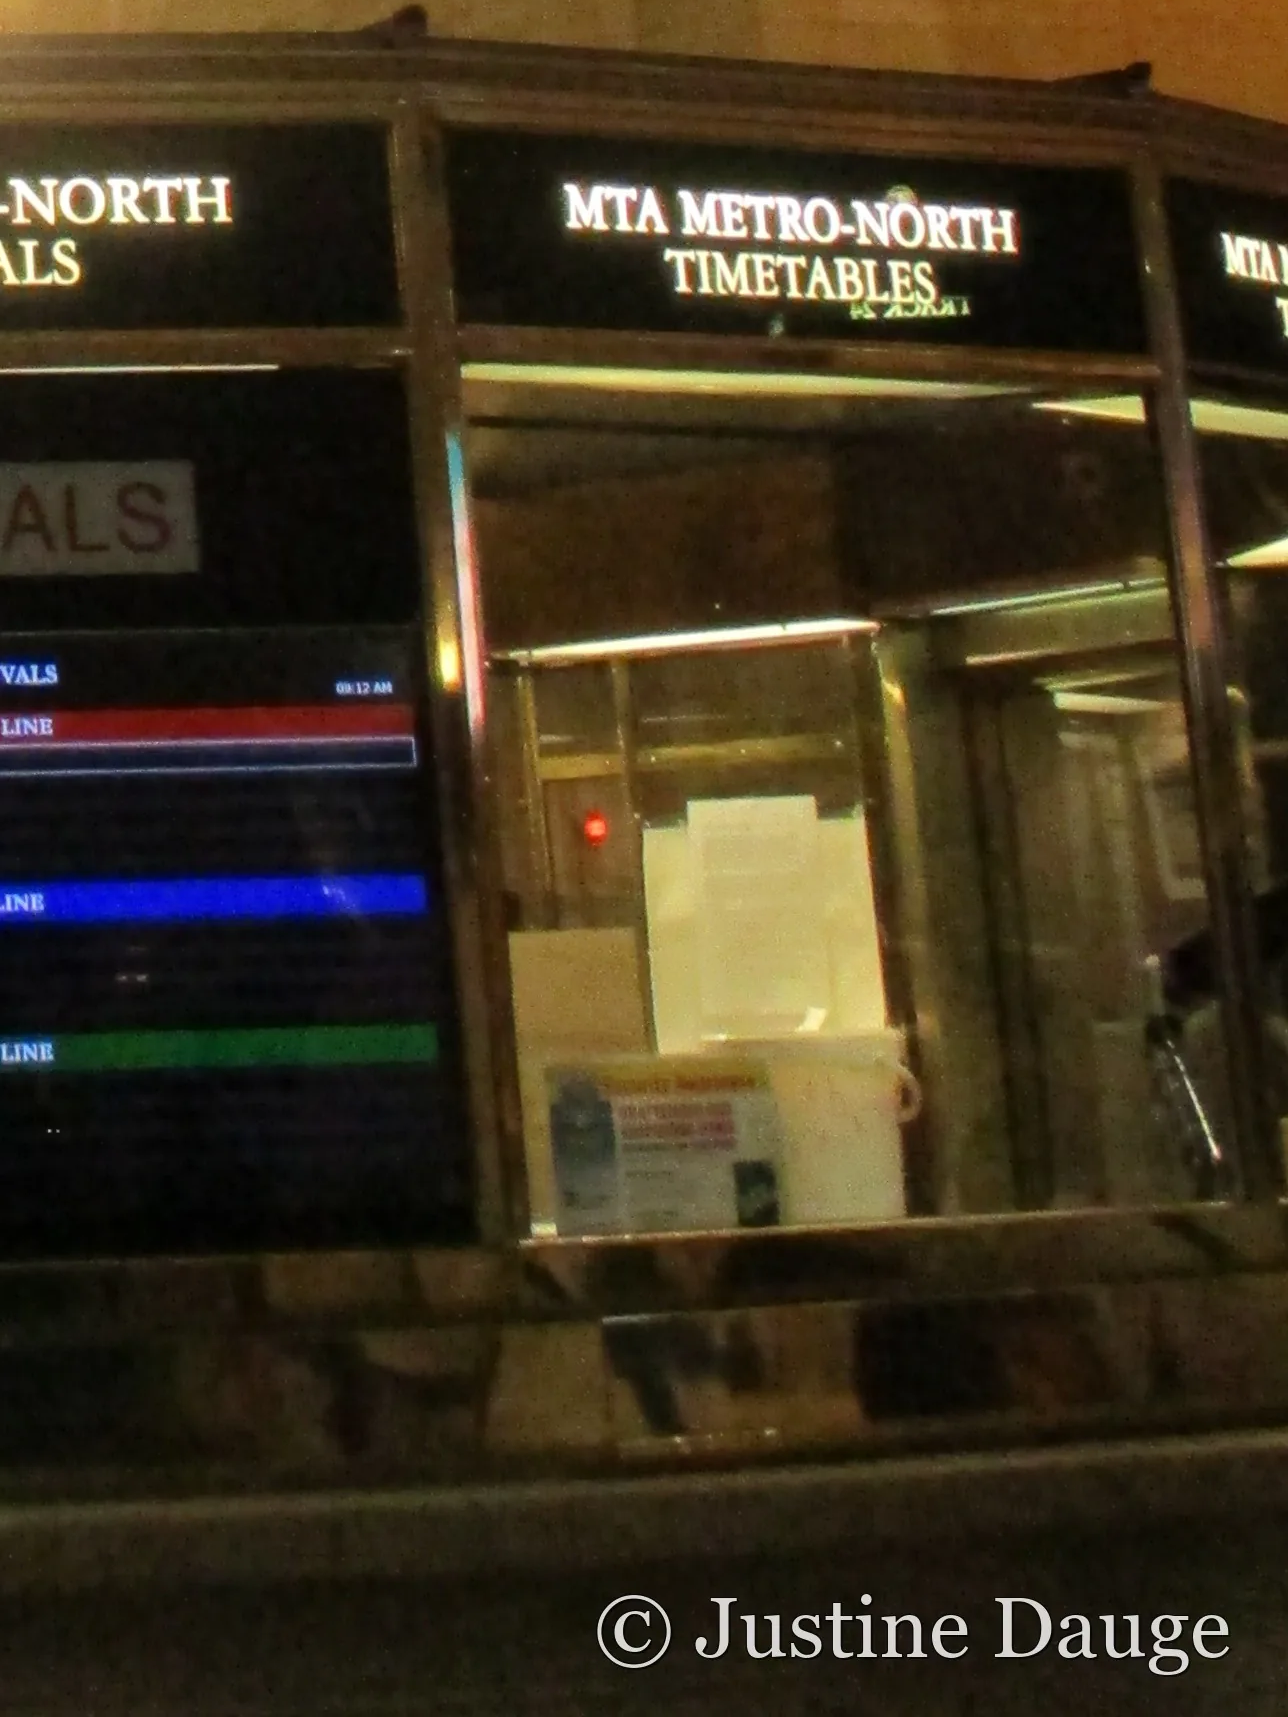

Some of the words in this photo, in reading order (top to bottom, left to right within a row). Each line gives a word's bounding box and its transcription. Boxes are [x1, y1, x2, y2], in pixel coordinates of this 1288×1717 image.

[563, 183, 669, 235] MTA
[678, 190, 1020, 254] METRO-NORTH
[663, 248, 938, 304] TIMETABLES
[1220, 232, 1280, 285] MTA
[1, 718, 53, 736] LINE
[0, 1042, 55, 1062] LINE
